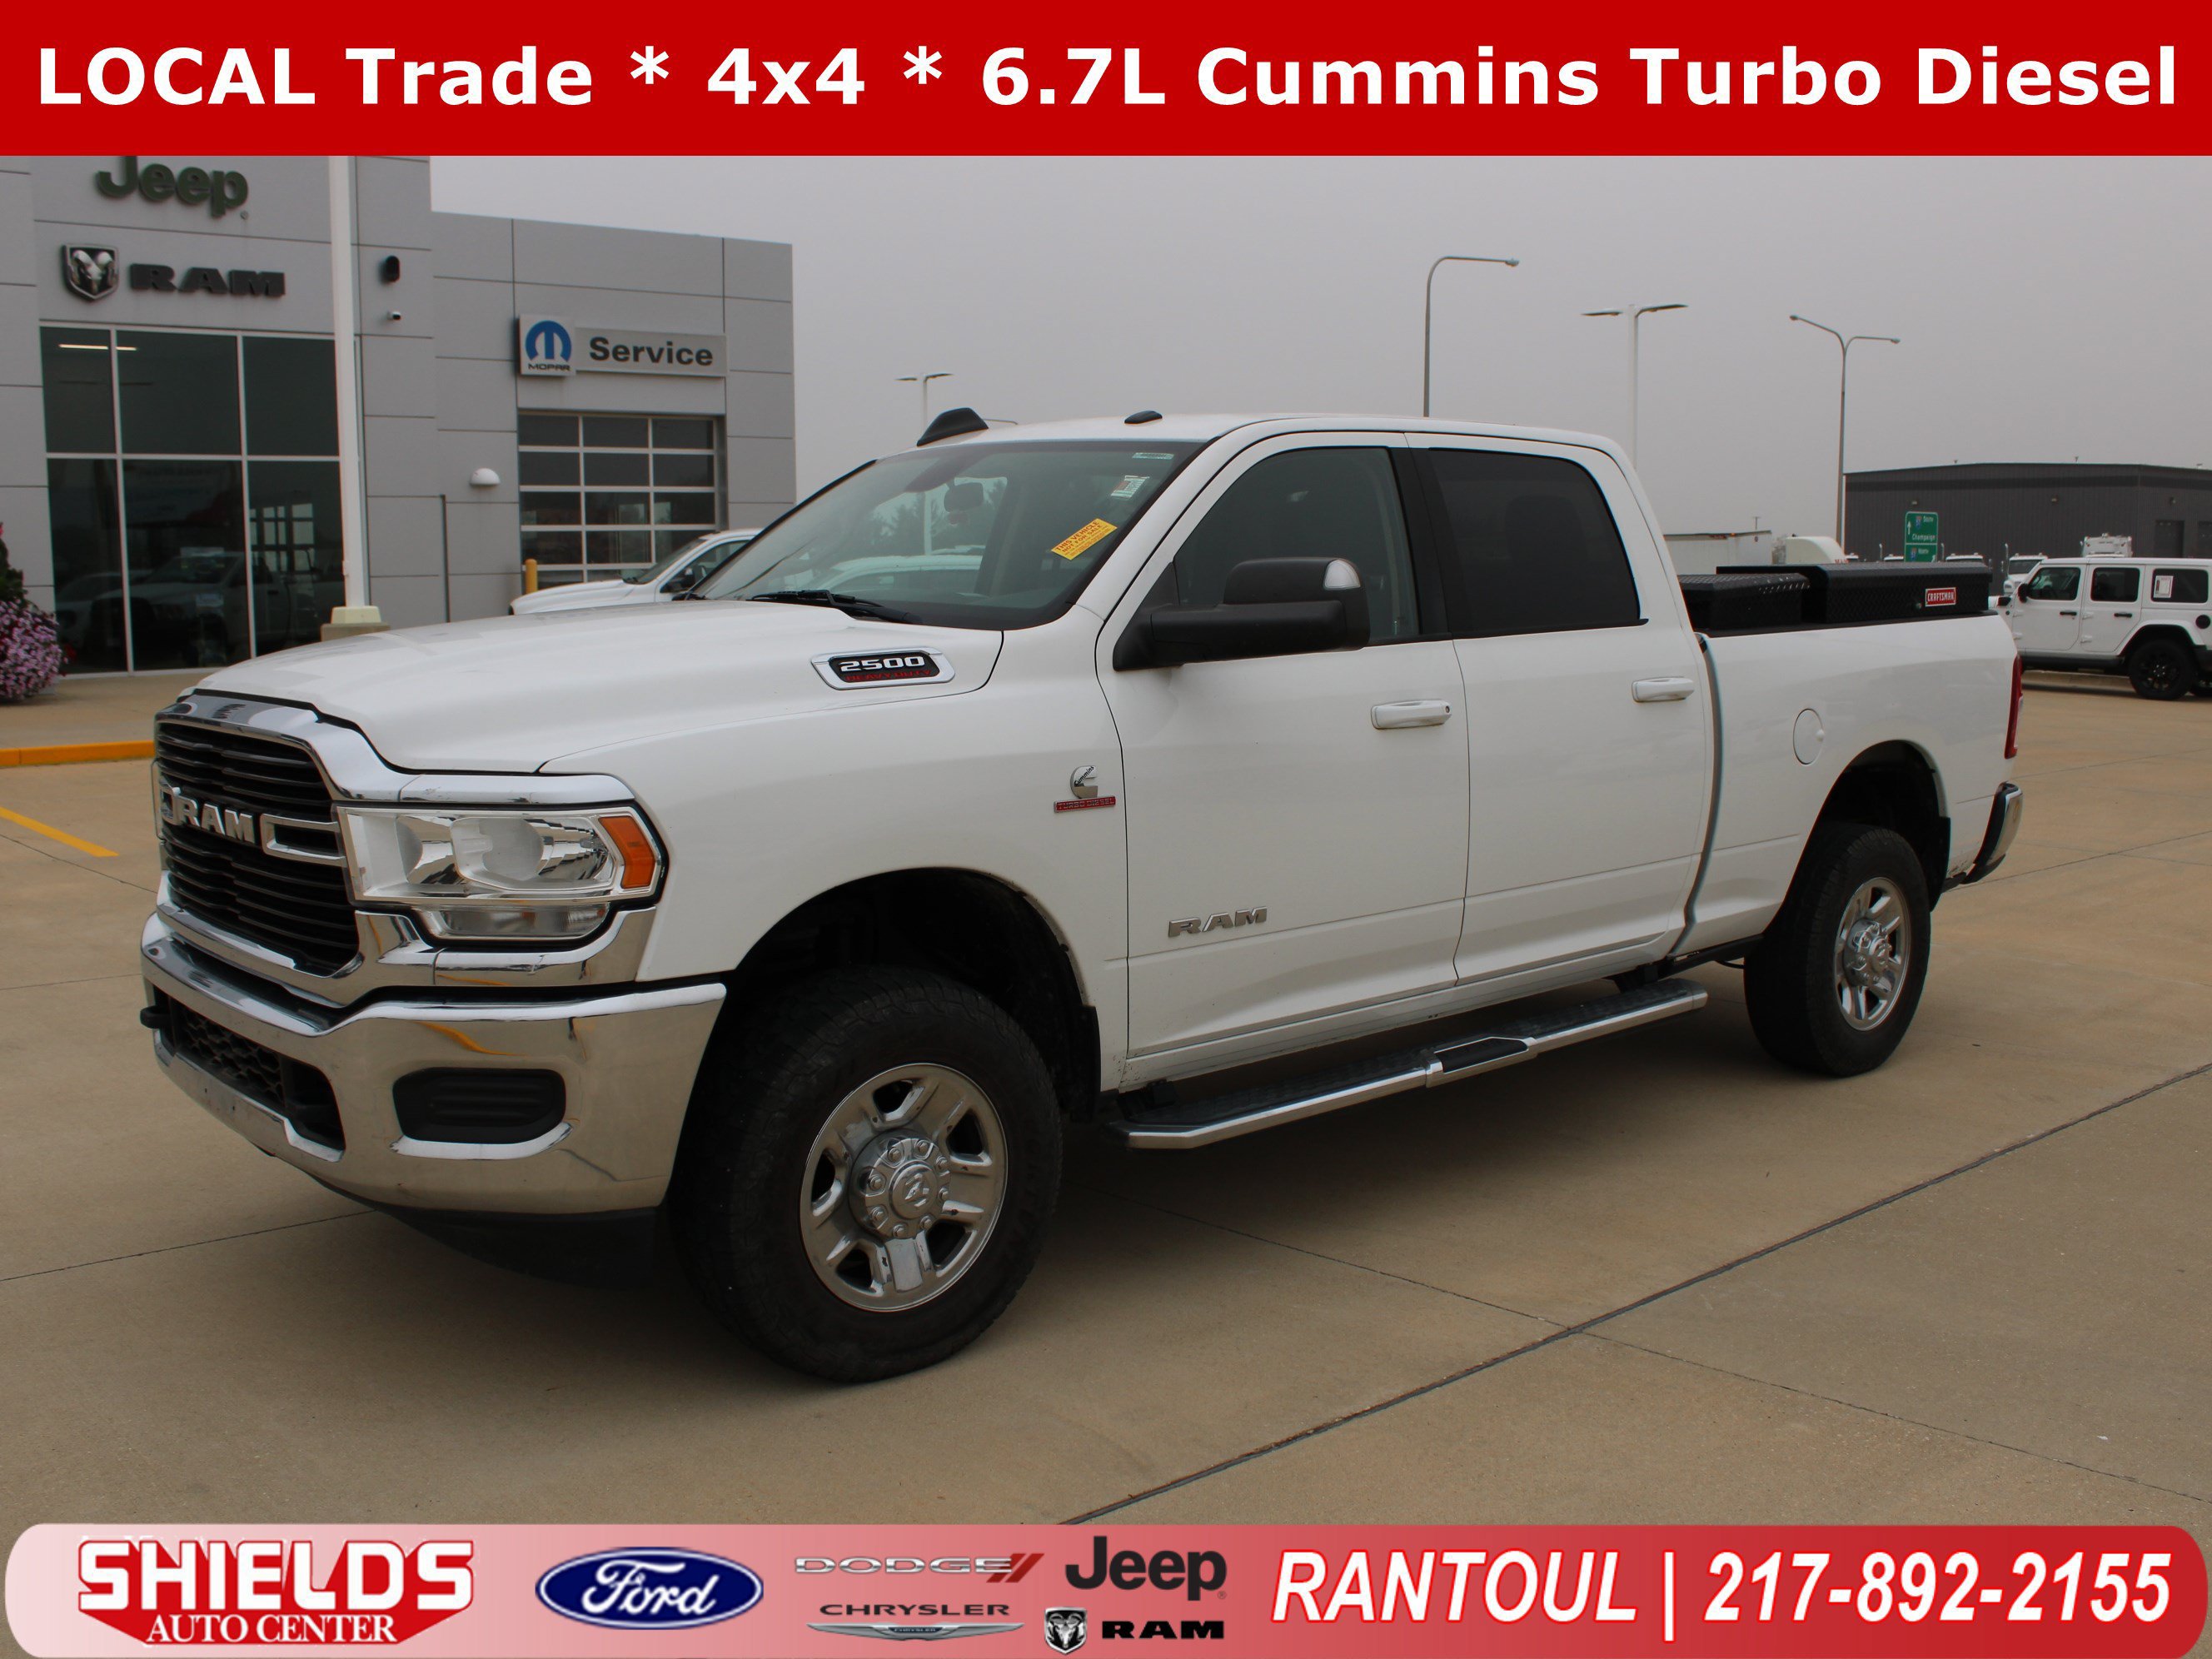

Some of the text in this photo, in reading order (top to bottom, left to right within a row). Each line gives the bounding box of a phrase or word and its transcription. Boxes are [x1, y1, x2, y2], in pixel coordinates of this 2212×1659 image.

[96, 156, 248, 218] Jeep
[128, 263, 286, 297] RAM
[589, 336, 714, 366] Service
[527, 362, 571, 371] MOPAR
[1055, 540, 1072, 551] THIS
[1070, 521, 1099, 541] VEHICLE
[1062, 543, 1074, 553] NOT
[1074, 535, 1087, 544] FOR
[1926, 591, 1955, 602] CRAFTSMAN
[839, 656, 925, 672] 2500
[845, 669, 932, 681] HEAVY DUTY
[1057, 797, 1115, 810] TURBO DIESEL
[178, 794, 256, 844] RAM
[1168, 906, 1268, 937] RAM
